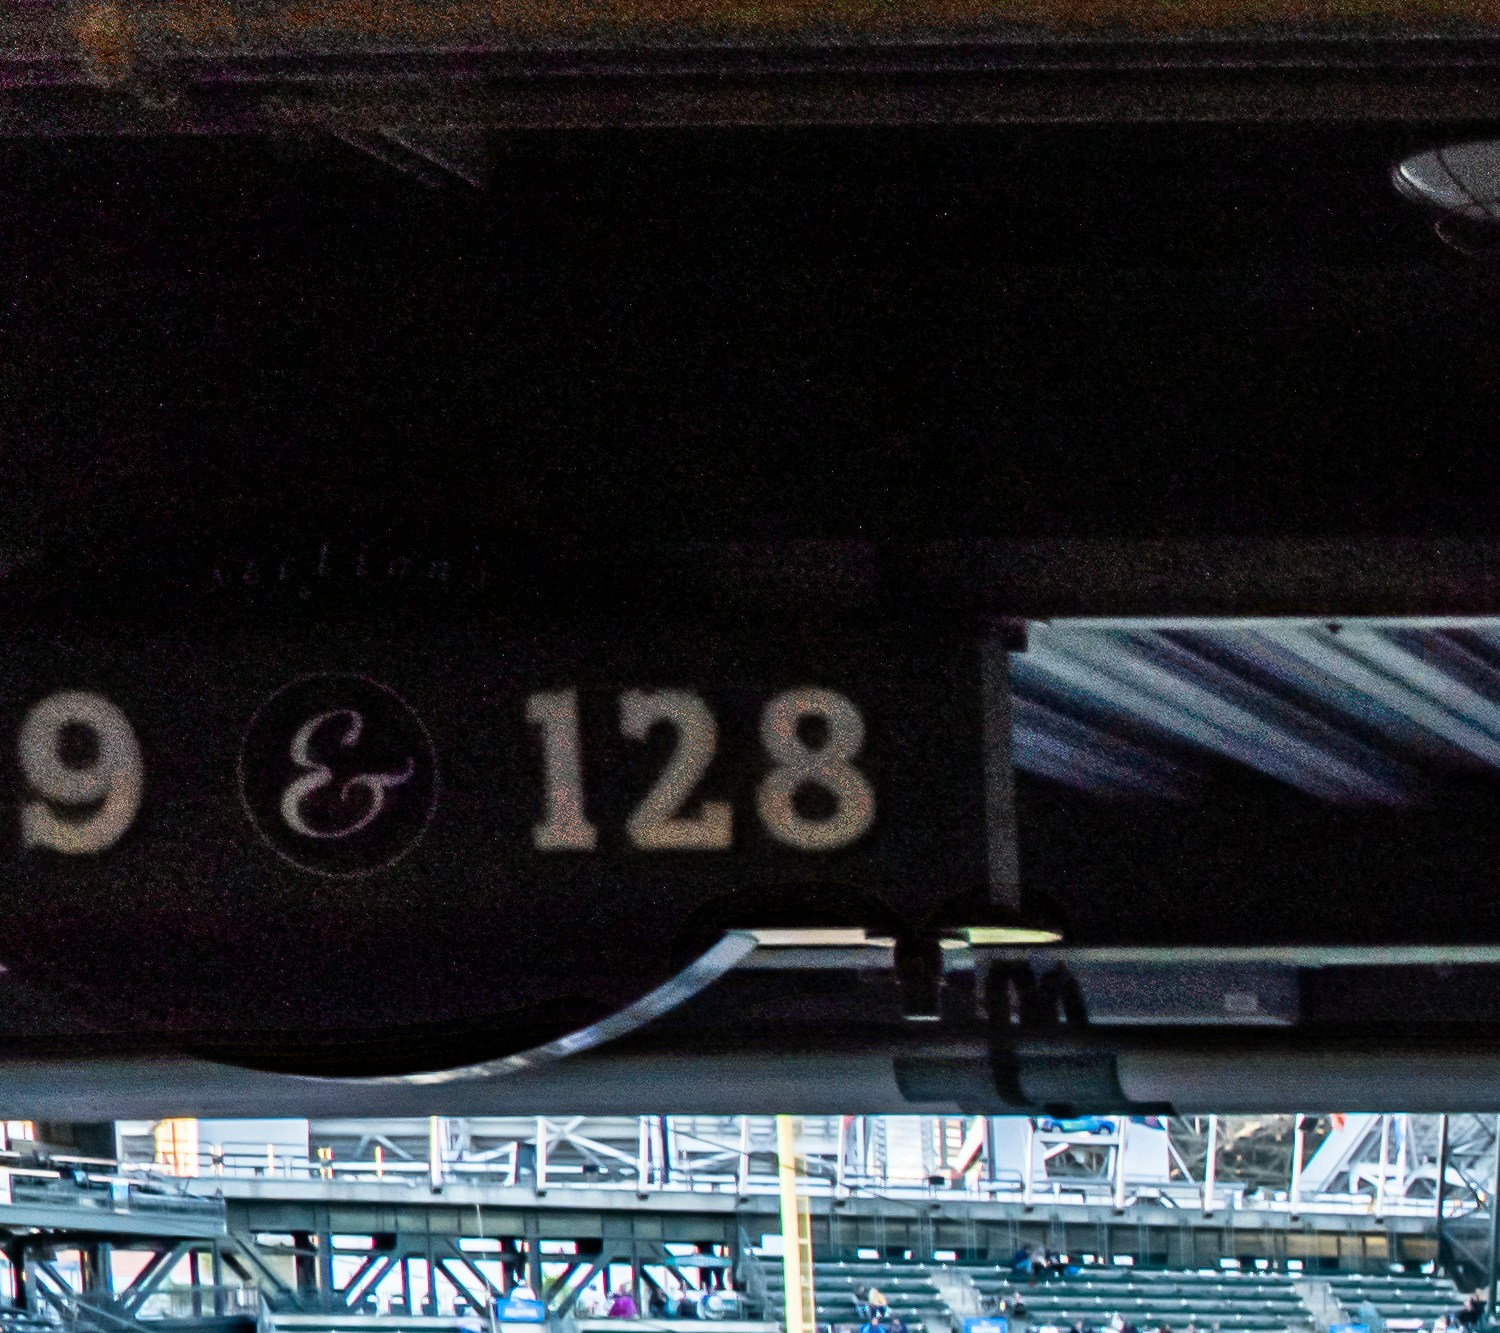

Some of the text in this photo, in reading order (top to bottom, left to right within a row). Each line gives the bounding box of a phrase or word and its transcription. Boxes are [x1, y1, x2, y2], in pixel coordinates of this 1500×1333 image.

[17, 685, 877, 855] 9 & 128
